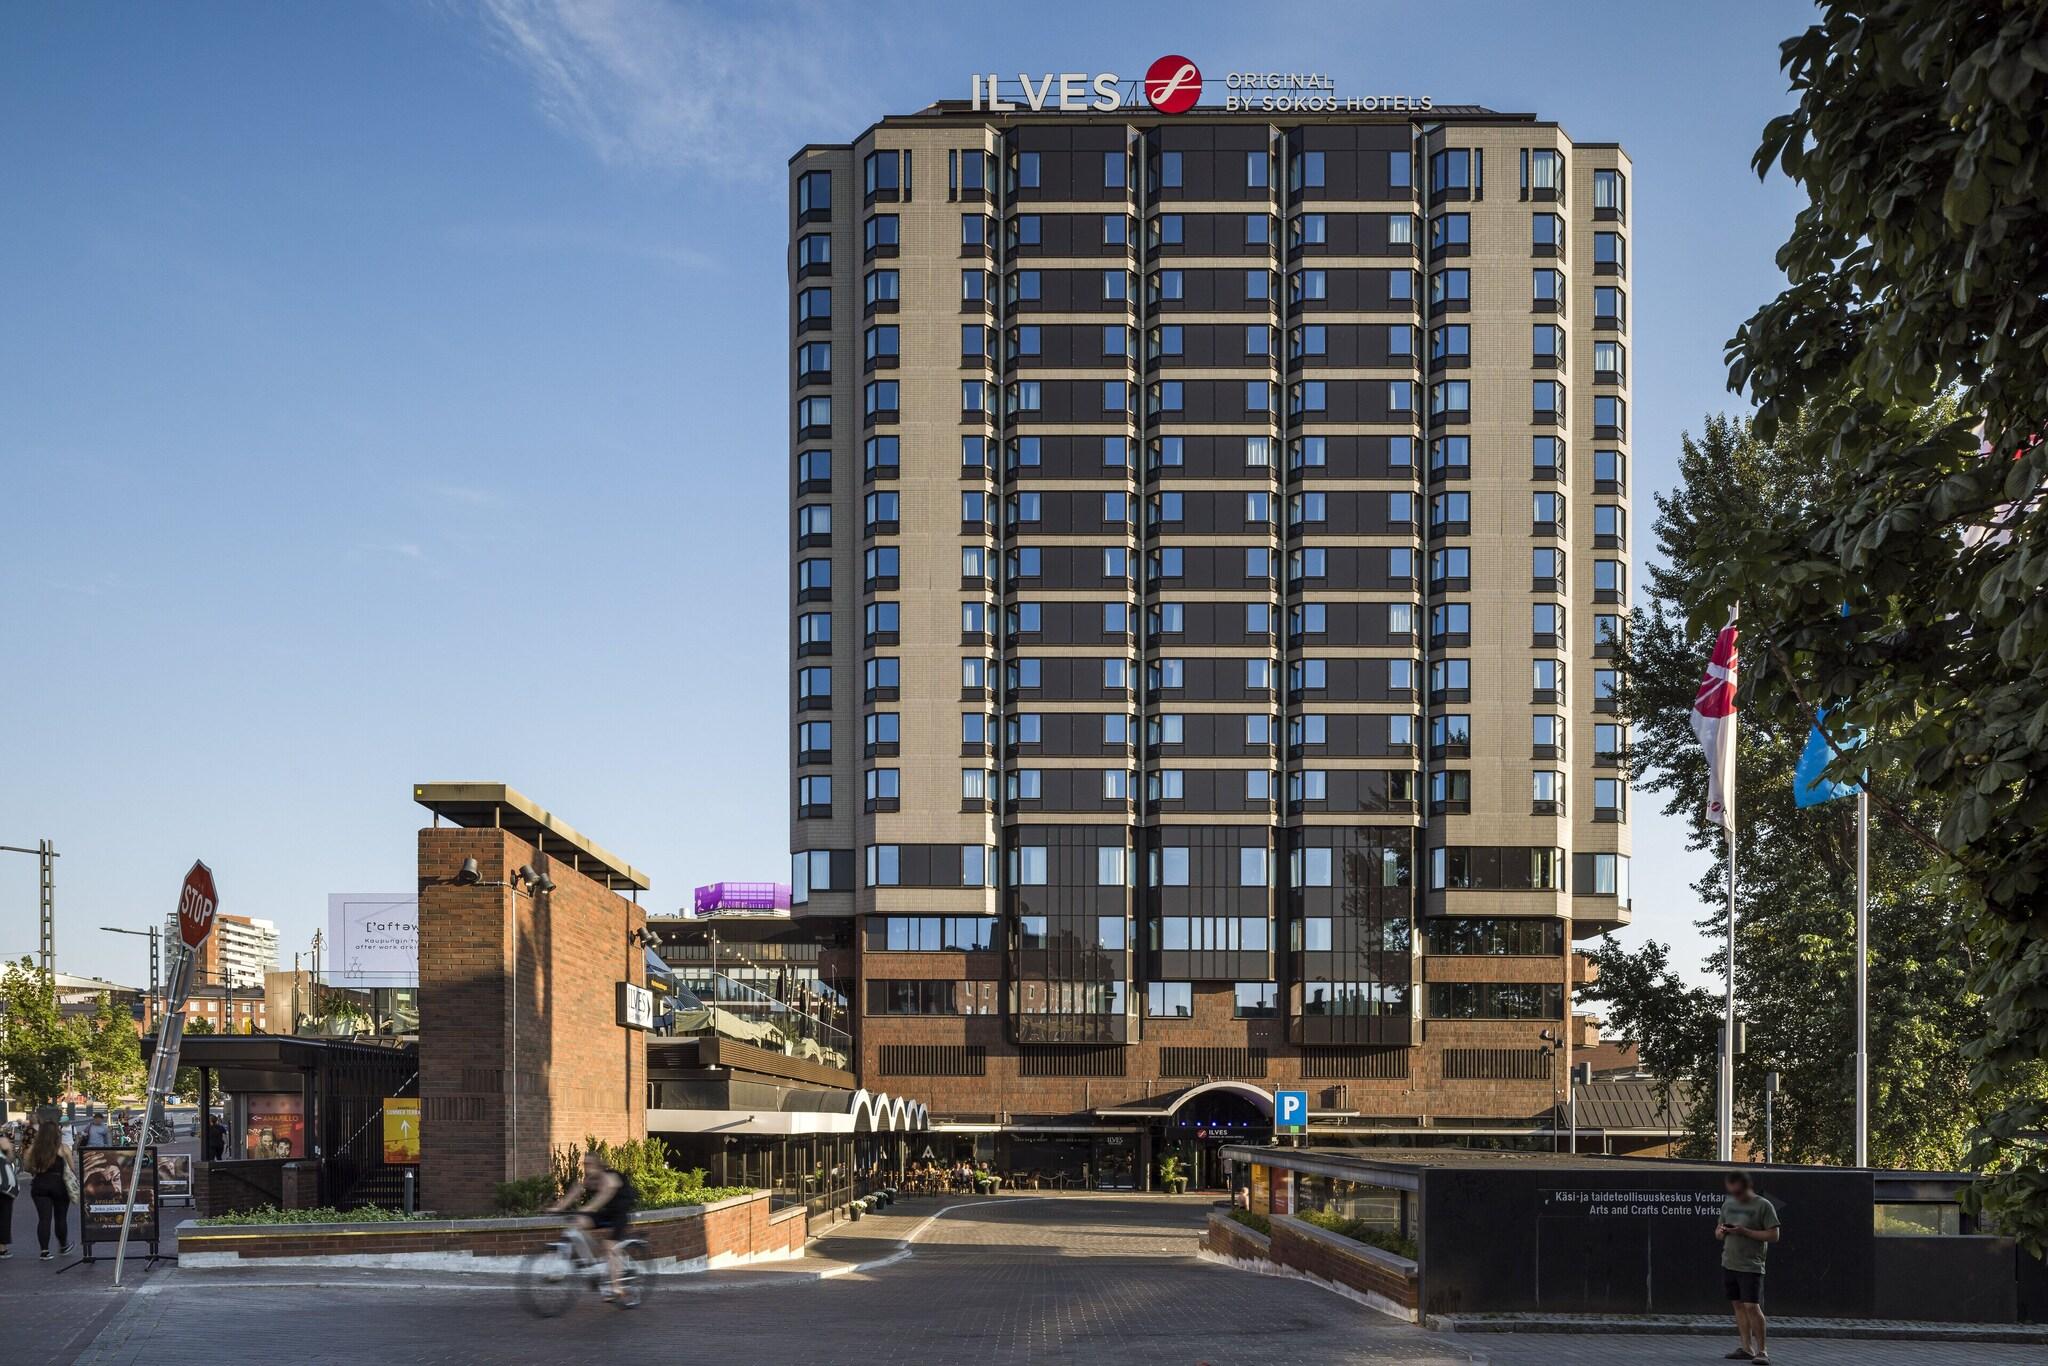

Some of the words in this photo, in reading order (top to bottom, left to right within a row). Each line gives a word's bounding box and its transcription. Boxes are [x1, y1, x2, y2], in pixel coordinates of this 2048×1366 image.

[1226, 72, 1334, 90] ORIGINAL
[972, 73, 1121, 112] ILVES
[1226, 95, 1254, 112] BY
[1262, 95, 1337, 112] SOKOS
[1347, 95, 1433, 112] HOTELS
[181, 884, 213, 927] STOP
[627, 987, 646, 1013] ILVES
[1283, 1096, 1300, 1121] P
[1591, 1191, 1692, 1202] taideteollisuuskeskus
[1694, 1192, 1724, 1203] Verkar
[1589, 1204, 1609, 1215] Arts
[1611, 1204, 1629, 1215] and
[1631, 1204, 1659, 1215] Crafts
[1661, 1204, 1692, 1215] Centre
[1694, 1205, 1721, 1215] Verka
